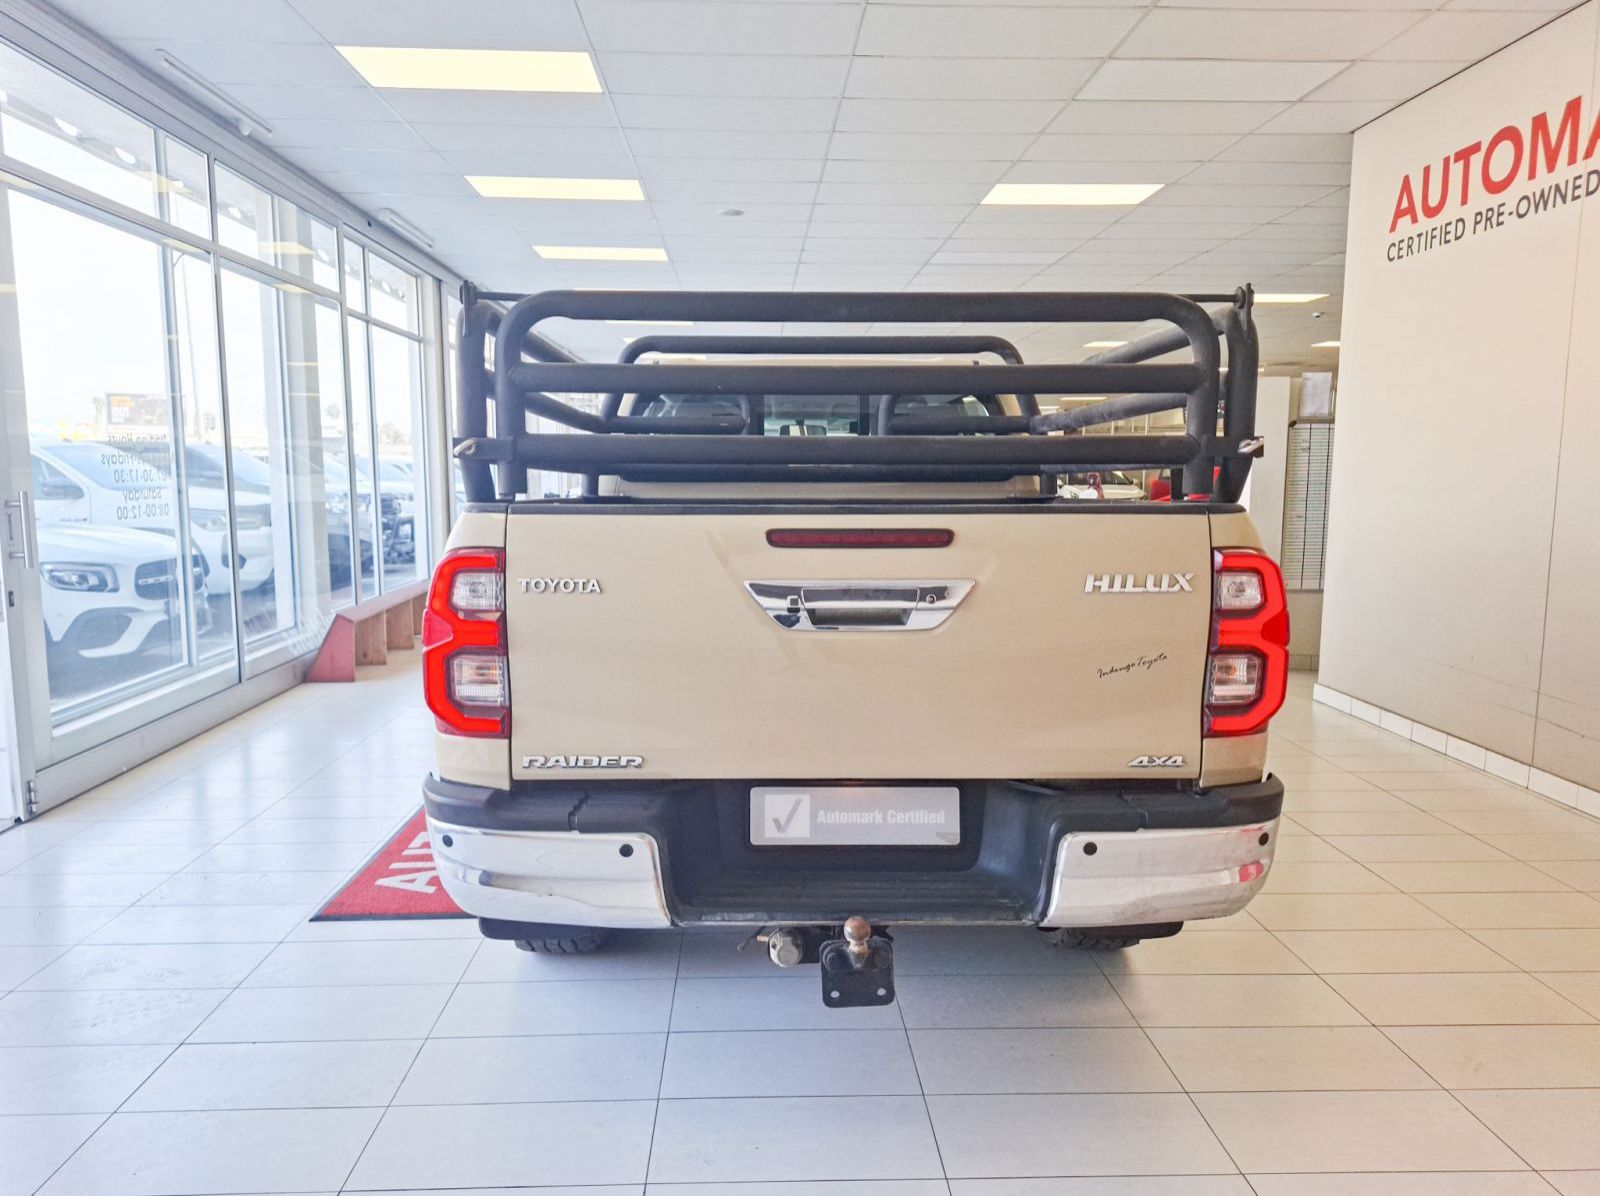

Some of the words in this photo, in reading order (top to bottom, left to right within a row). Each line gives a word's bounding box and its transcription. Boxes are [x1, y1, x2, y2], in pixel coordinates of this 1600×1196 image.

[1387, 217, 1466, 262] CERTIFIED
[1473, 169, 1600, 235] PRE-OWNED
[518, 576, 603, 594] TOYOTA
[1084, 572, 1194, 593] HILUX
[522, 754, 644, 769] RAIDER
[817, 809, 884, 824] Automark
[887, 809, 945, 824] Certified
